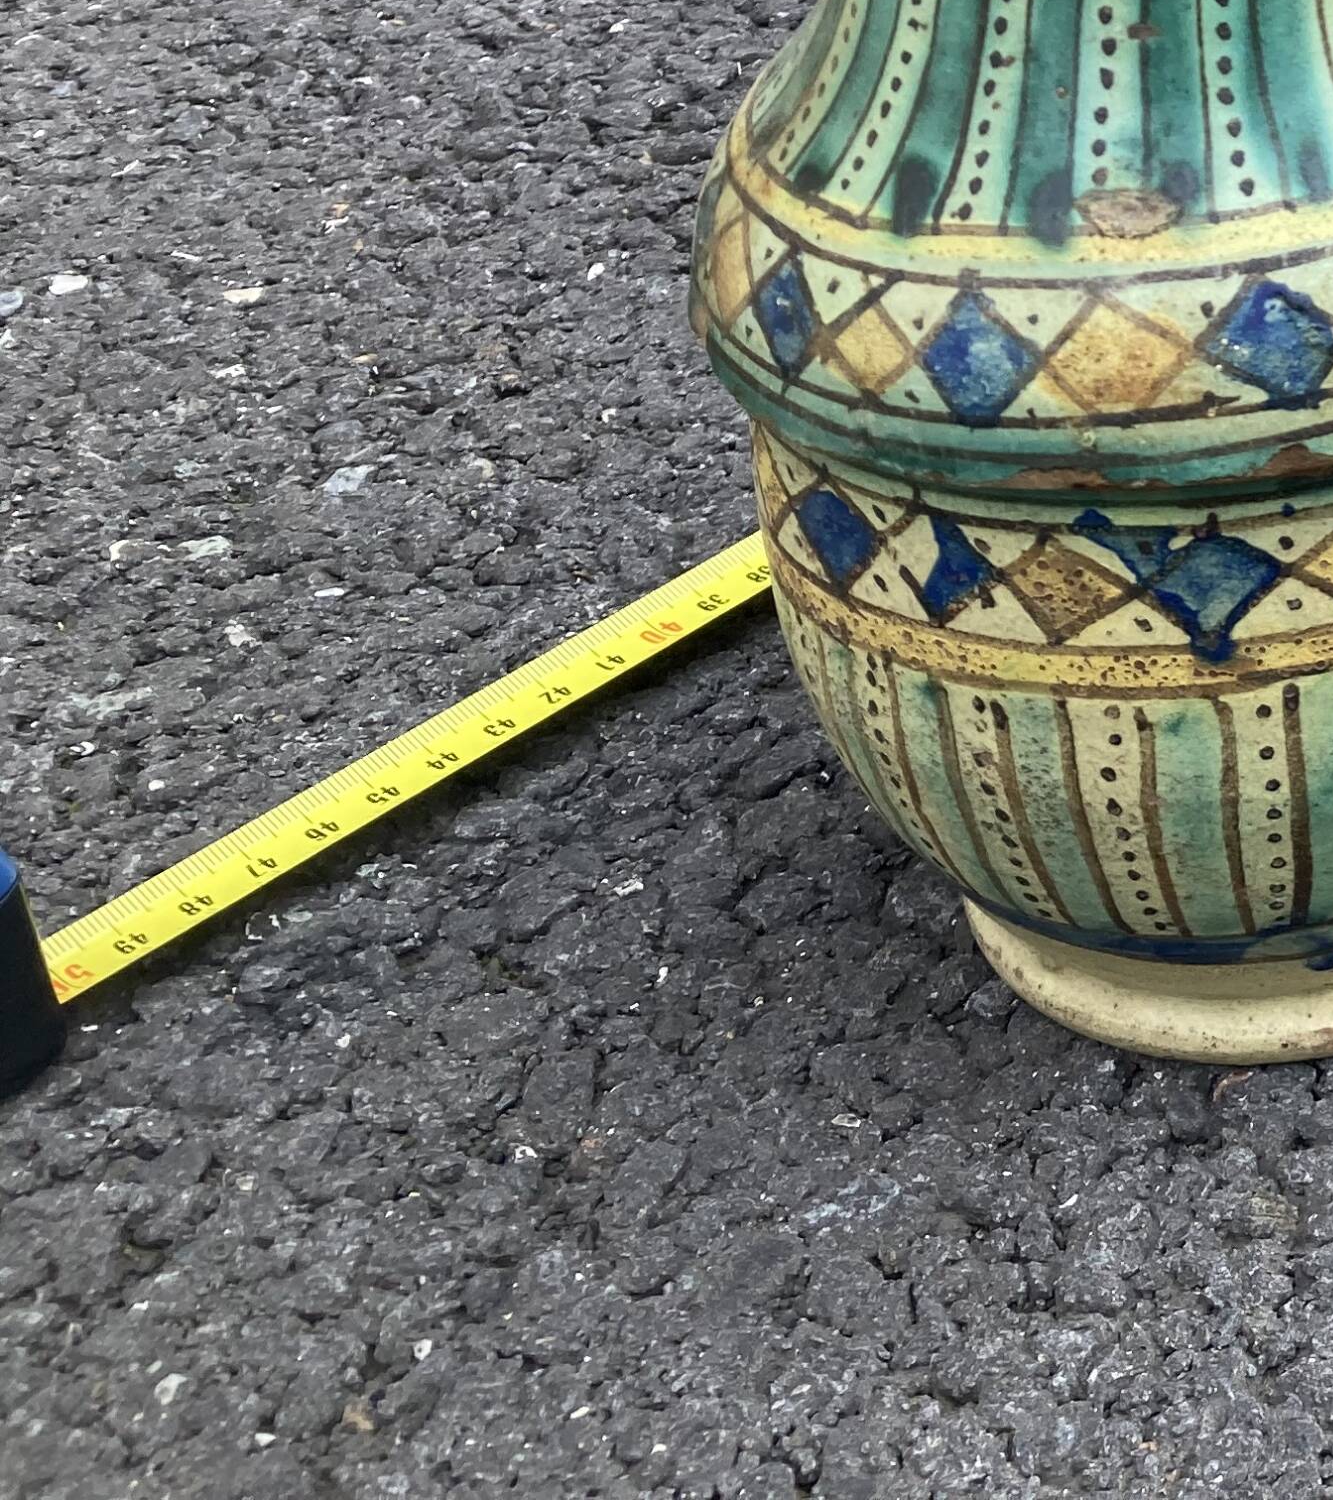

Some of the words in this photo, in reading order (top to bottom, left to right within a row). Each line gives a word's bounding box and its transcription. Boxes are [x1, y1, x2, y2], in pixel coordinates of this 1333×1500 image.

[746, 565, 770, 582] 38
[697, 594, 729, 612] 39
[640, 621, 683, 644] 40
[595, 654, 626, 671] 41
[537, 687, 572, 704] 42
[483, 718, 516, 737] 43
[426, 752, 460, 770] 44
[366, 786, 400, 805] 45
[305, 821, 340, 841] 46
[246, 857, 278, 878] 47
[178, 894, 214, 916] 48
[113, 932, 148, 955] 49
